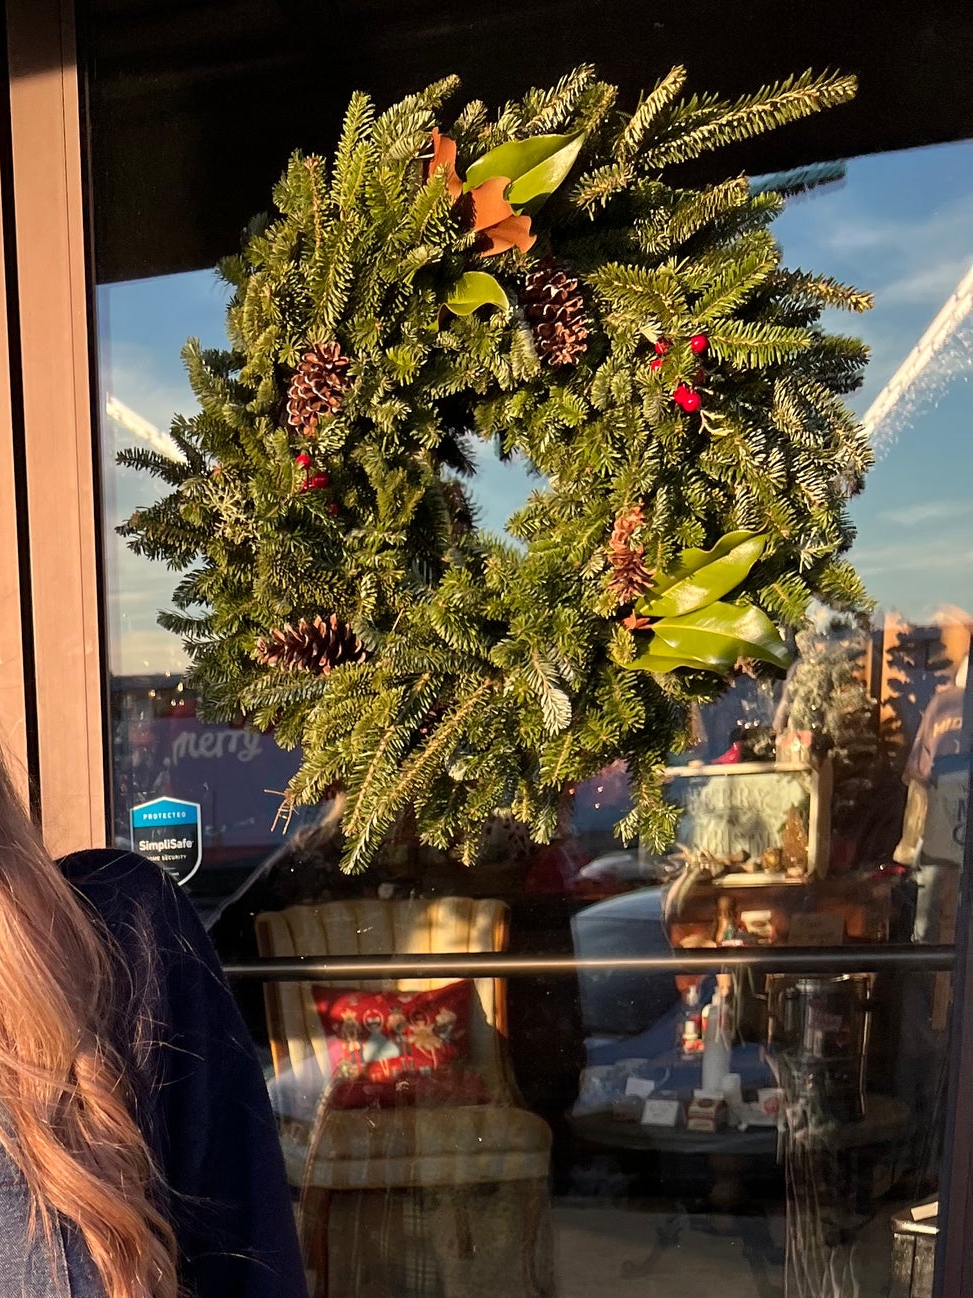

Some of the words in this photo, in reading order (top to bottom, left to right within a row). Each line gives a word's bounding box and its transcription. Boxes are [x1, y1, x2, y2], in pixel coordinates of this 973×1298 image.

[172, 729, 263, 766] merry
[143, 811, 187, 820] PROTECTED
[139, 838, 193, 852] SimpliSafe
